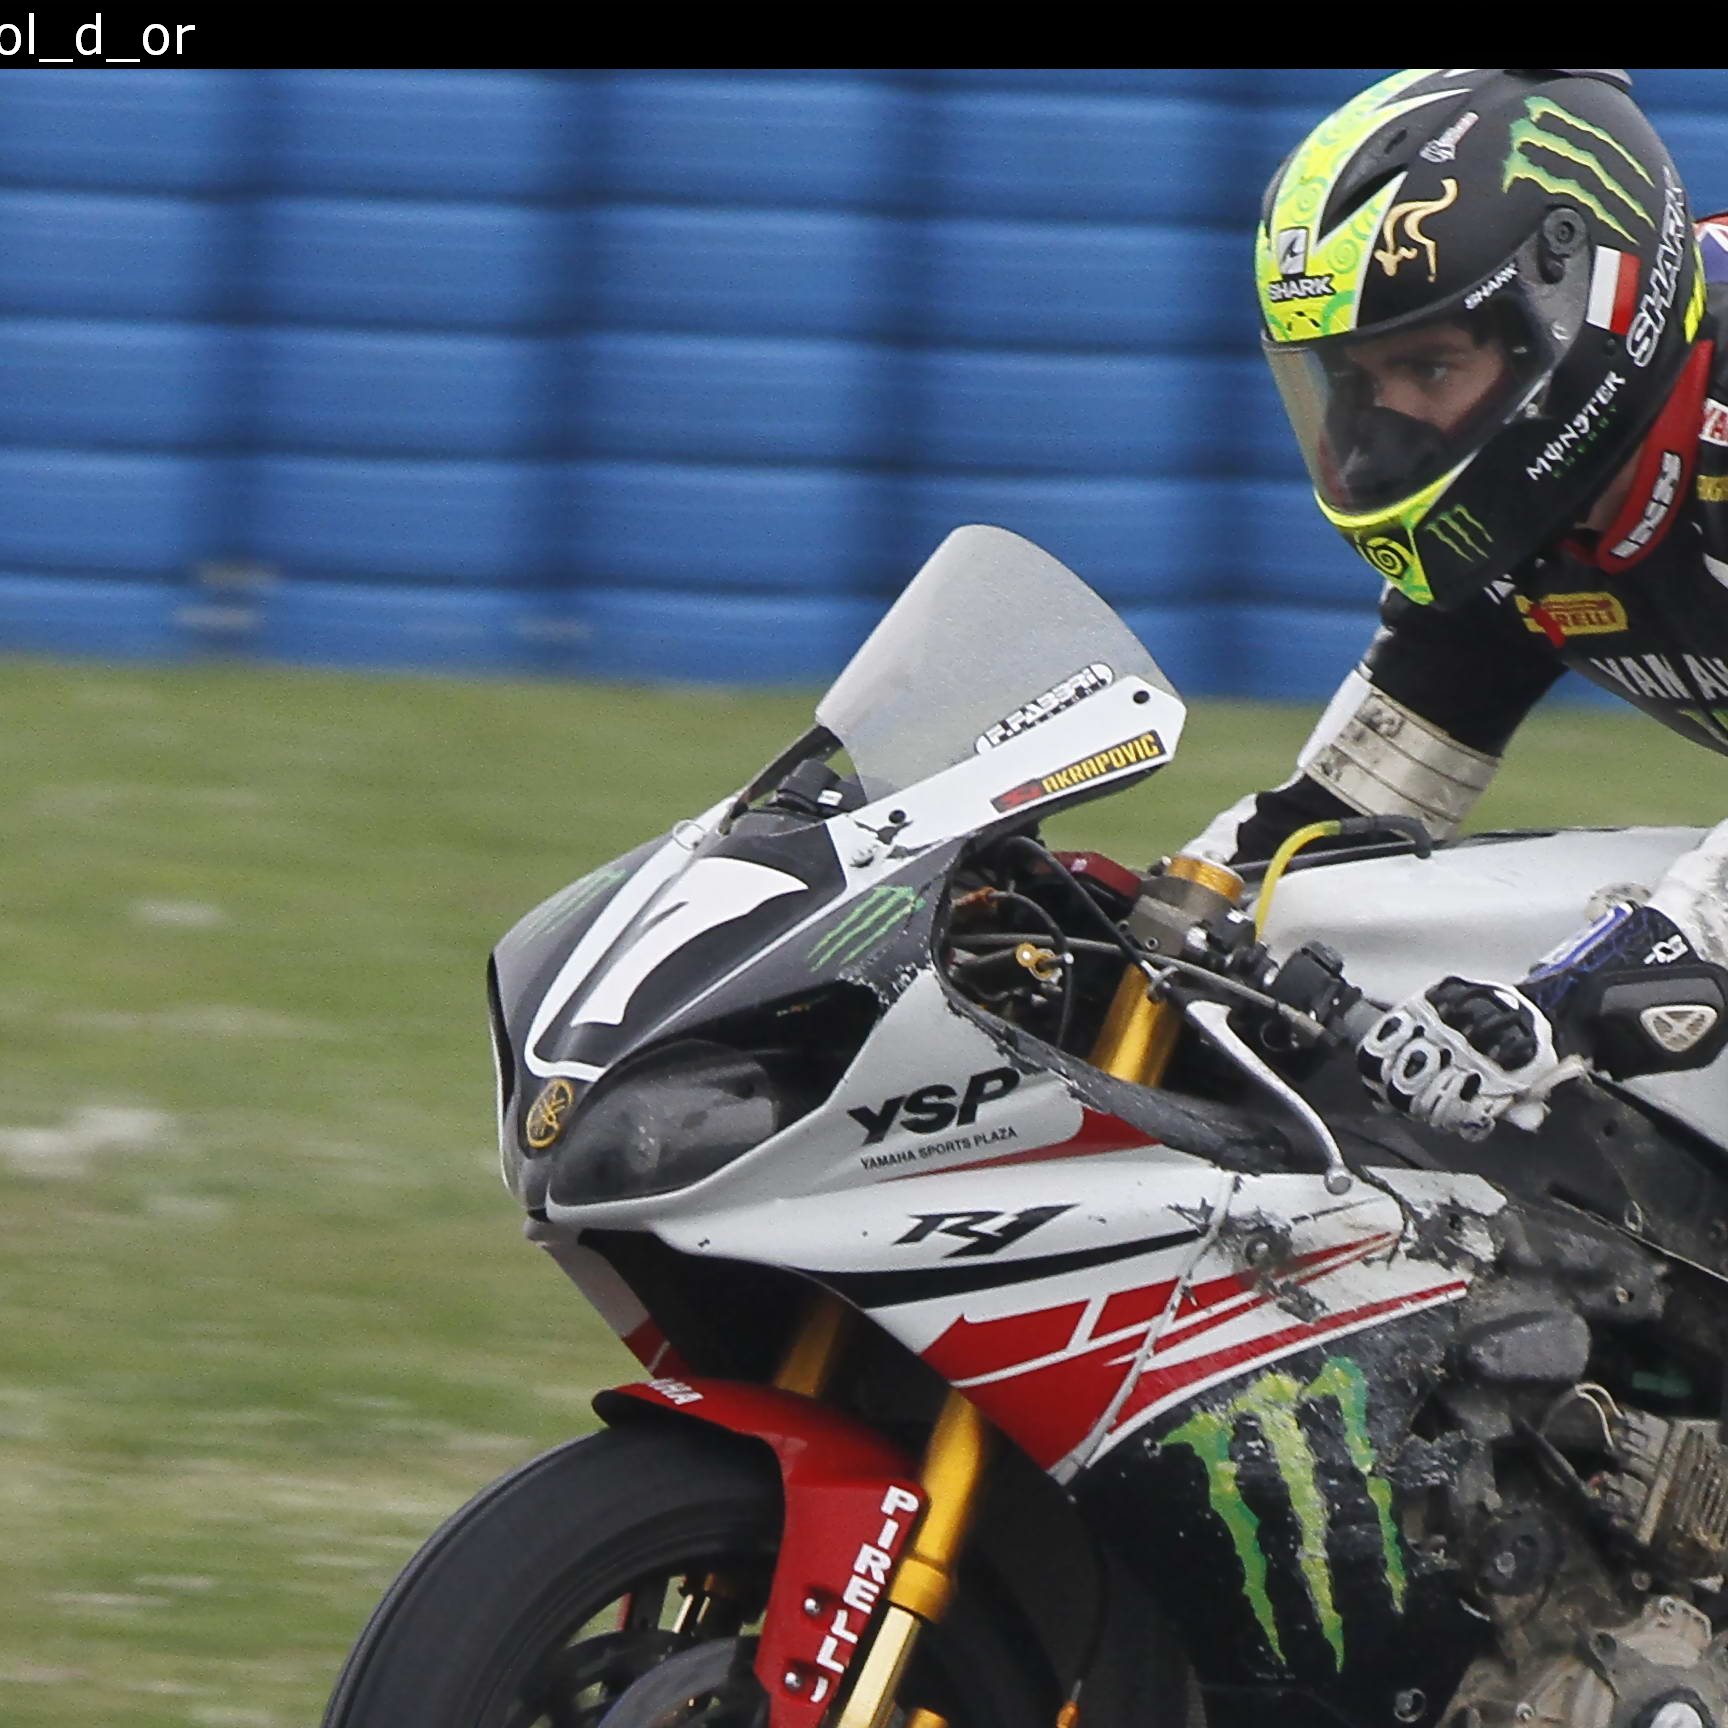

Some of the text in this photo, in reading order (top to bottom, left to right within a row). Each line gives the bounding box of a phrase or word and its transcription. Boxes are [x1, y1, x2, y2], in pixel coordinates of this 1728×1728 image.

[1267, 274, 1336, 302] SHARK
[1525, 370, 1627, 481] MONSTER
[846, 1065, 1021, 1147] YSP
[860, 1125, 1019, 1171] YAMAHA SPORTS PLAZA
